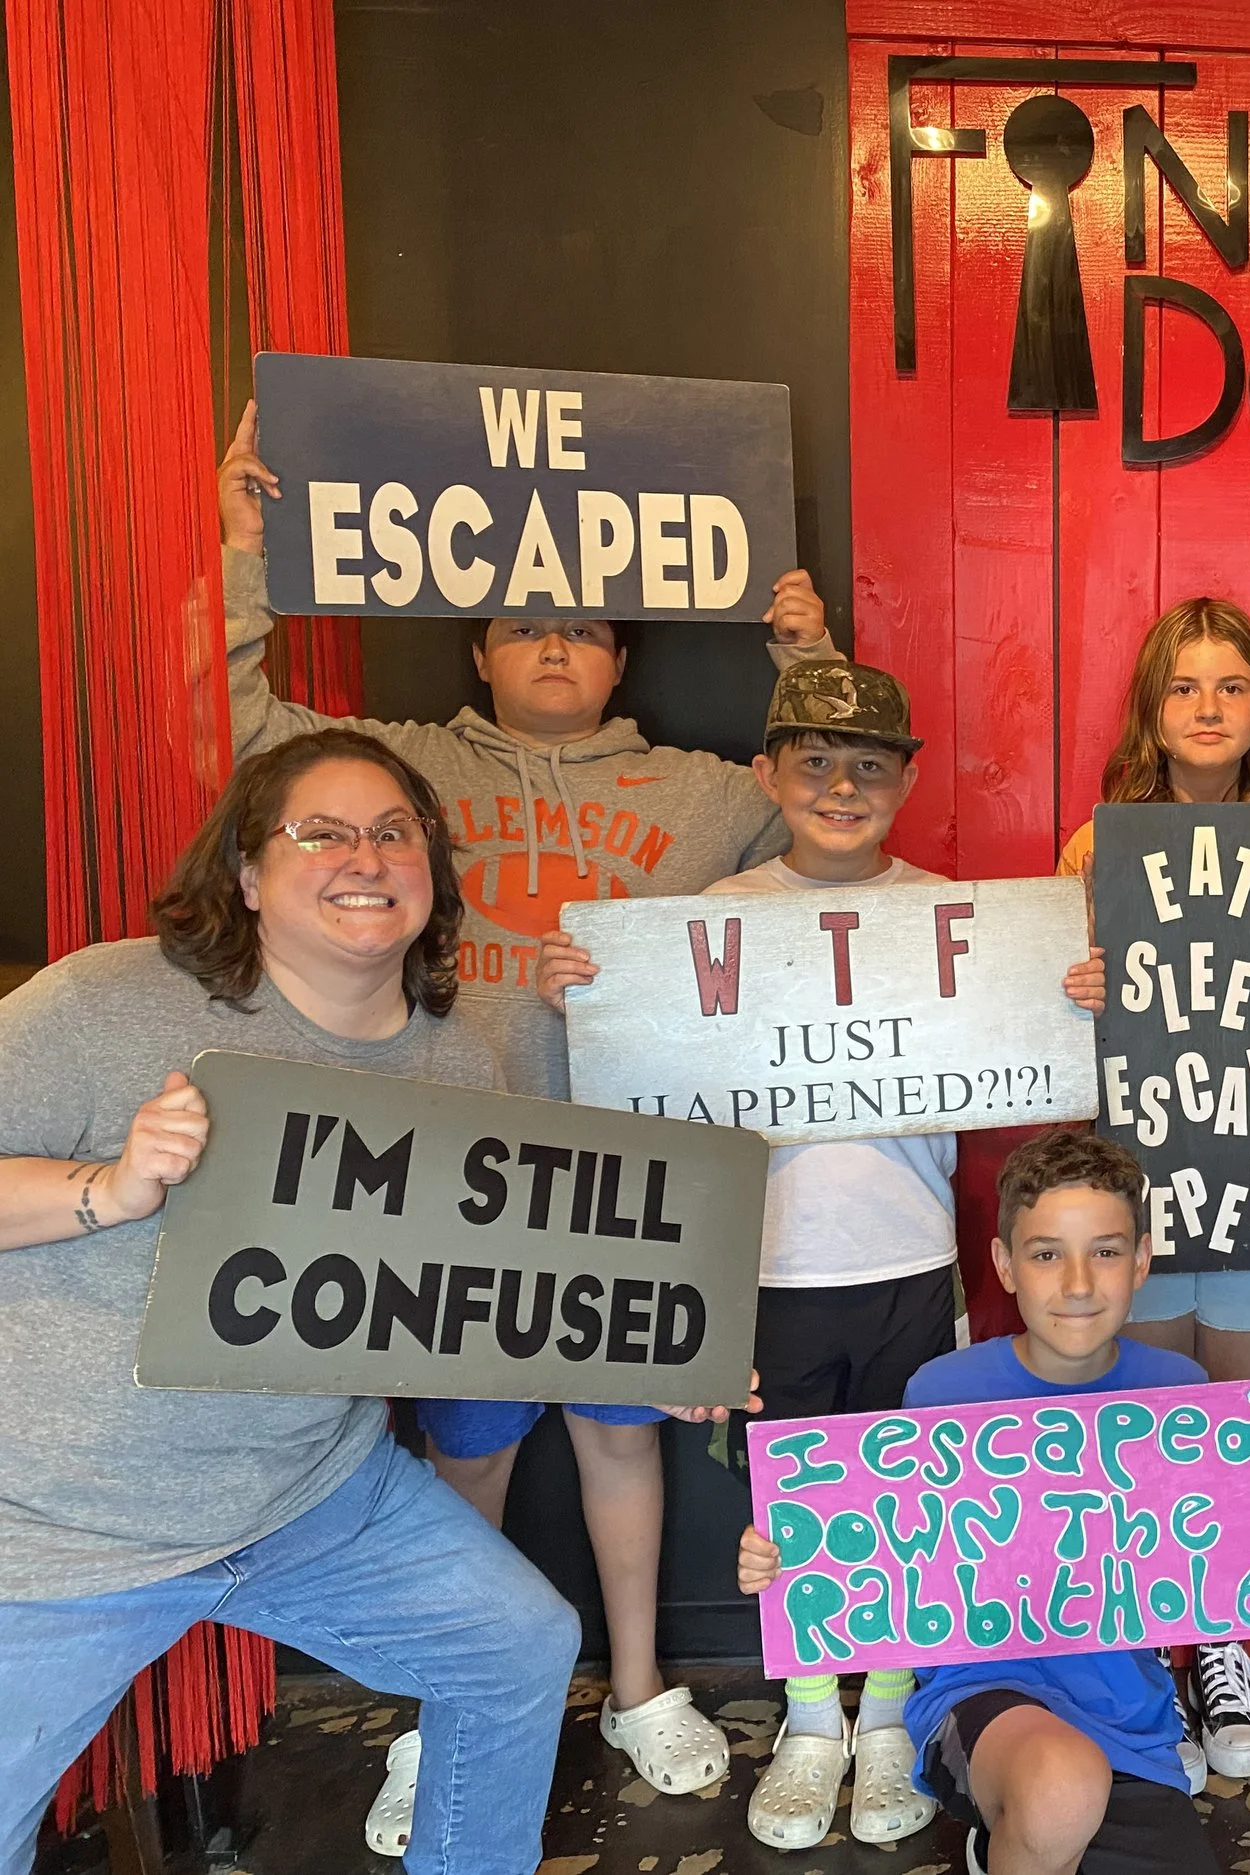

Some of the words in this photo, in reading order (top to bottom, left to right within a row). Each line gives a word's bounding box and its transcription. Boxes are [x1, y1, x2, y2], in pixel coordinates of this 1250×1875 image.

[479, 386, 587, 472] WE
[308, 481, 751, 611] ESCAPED
[769, 1016, 914, 1068] JUST
[271, 1111, 416, 1217] I'M
[456, 1136, 683, 1244] STILL
[207, 1246, 707, 1366] CONFUSED
[766, 1429, 848, 1492] I
